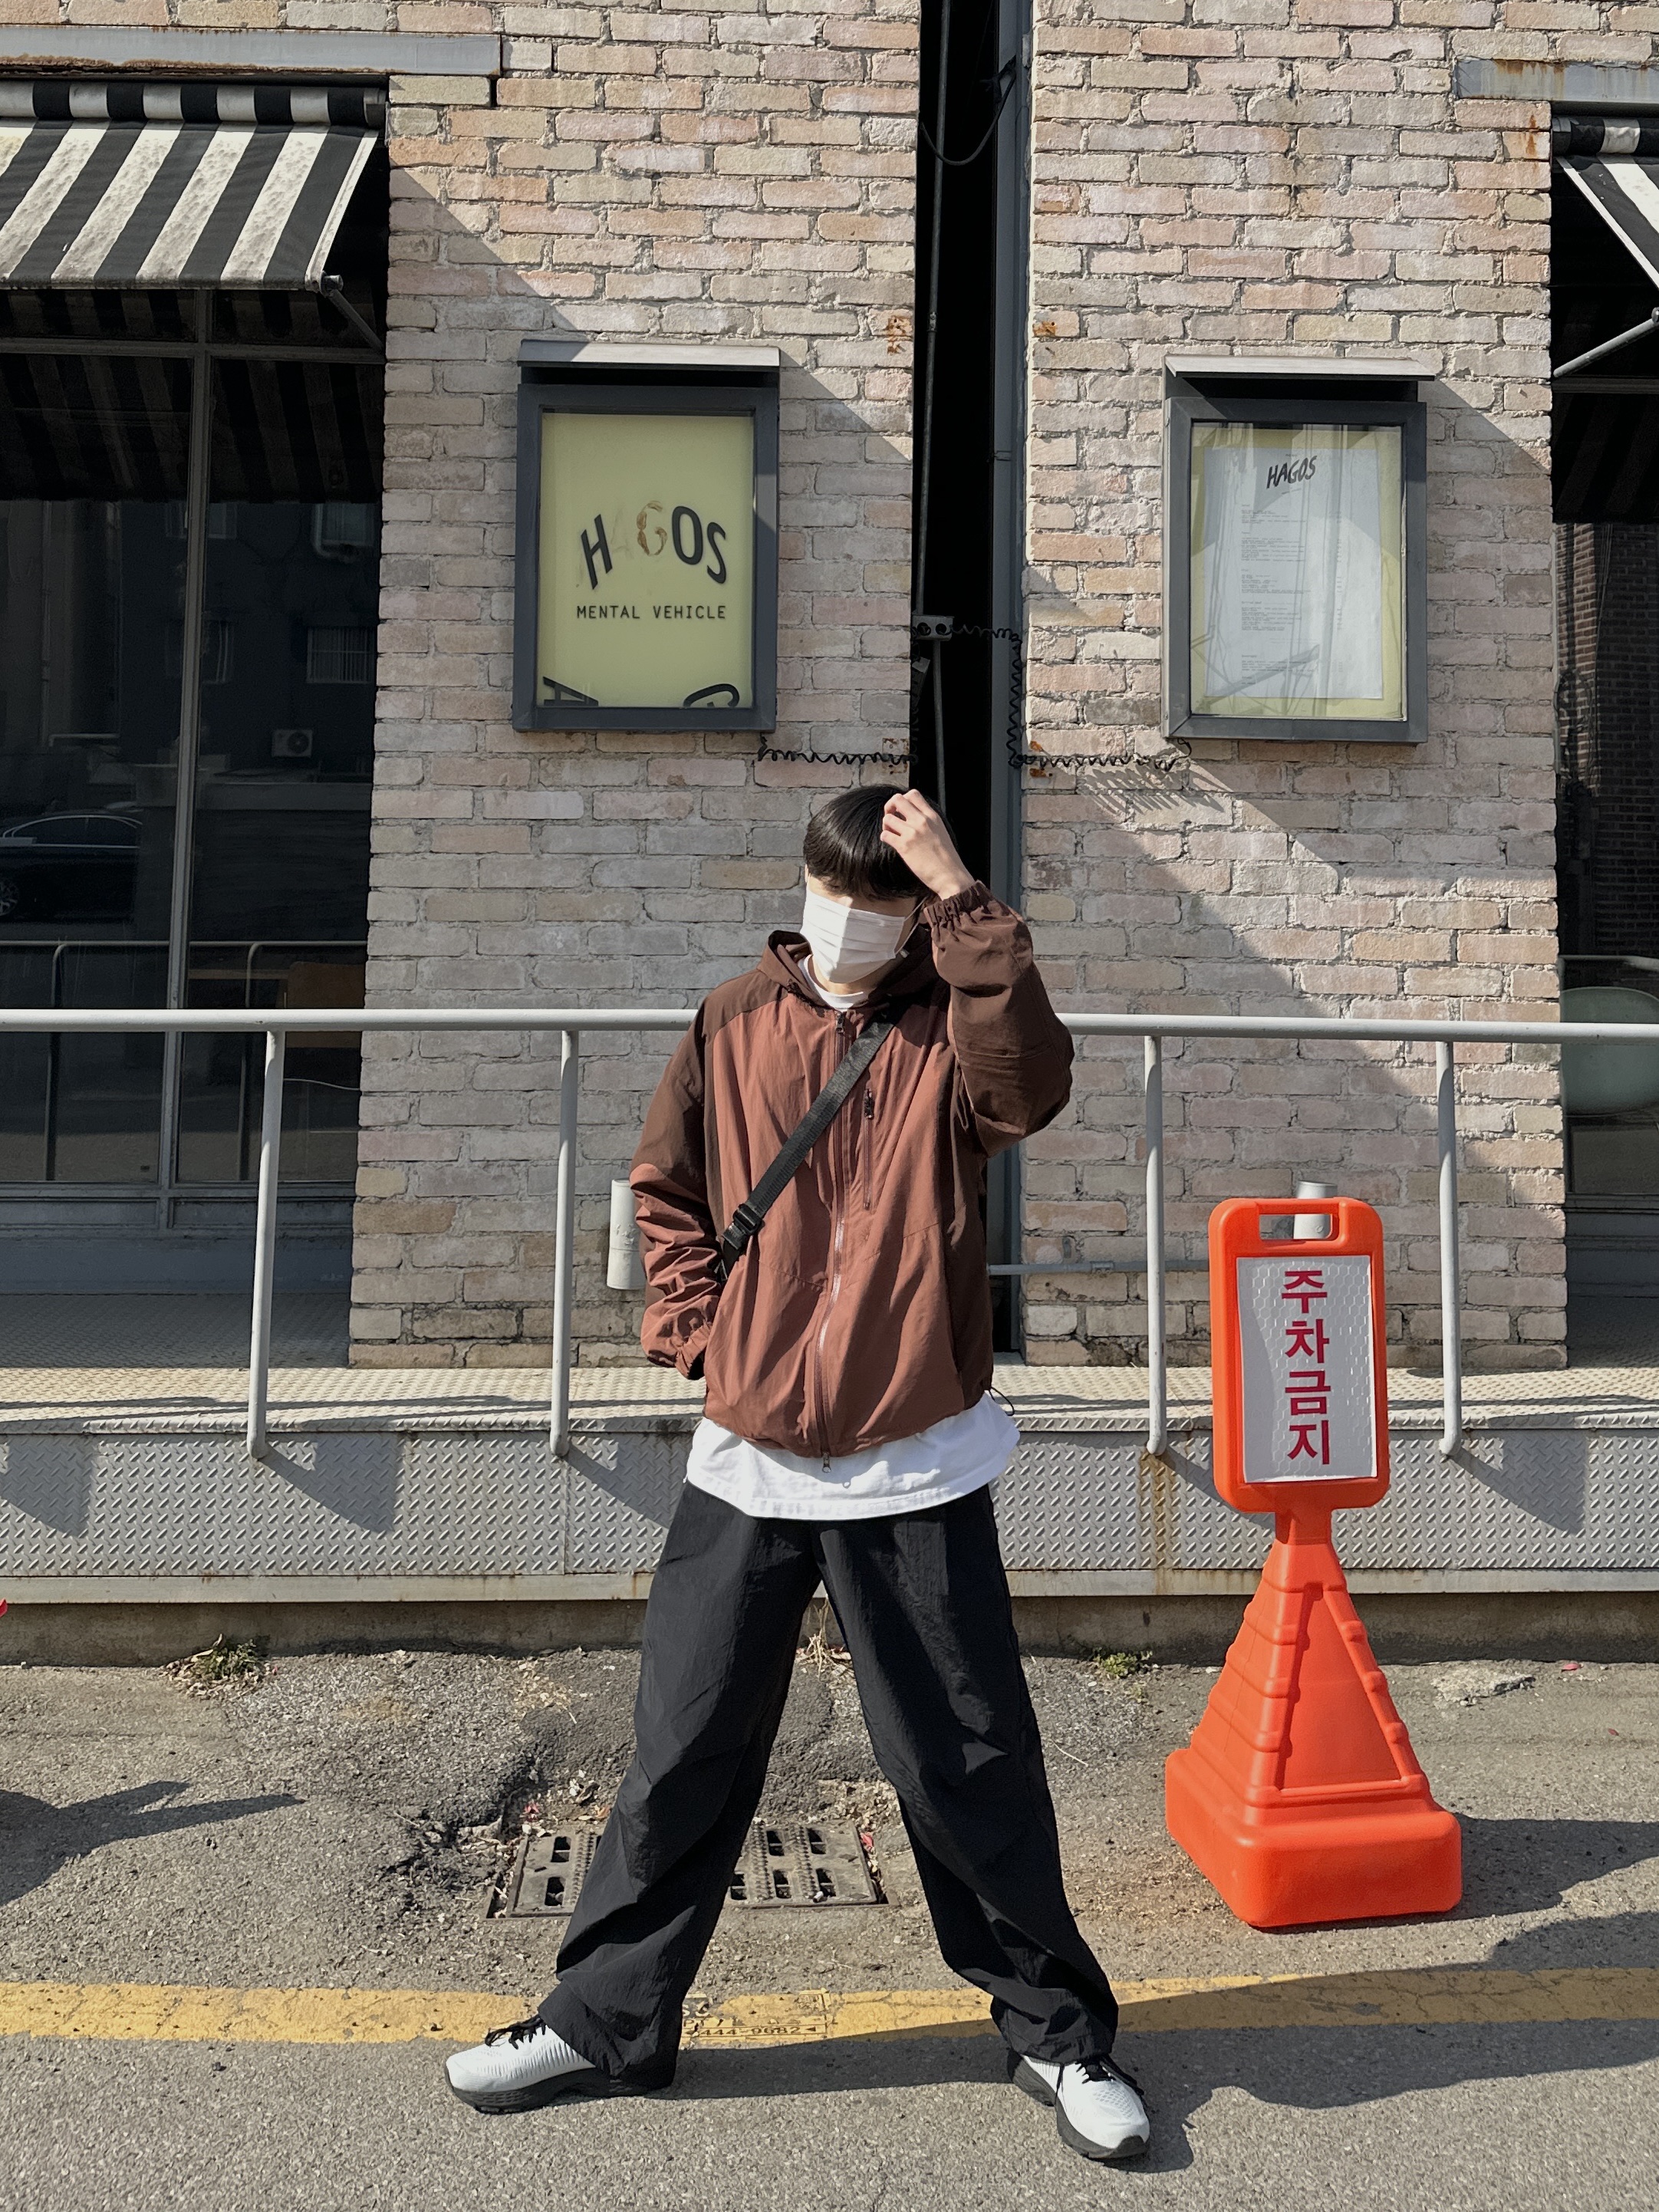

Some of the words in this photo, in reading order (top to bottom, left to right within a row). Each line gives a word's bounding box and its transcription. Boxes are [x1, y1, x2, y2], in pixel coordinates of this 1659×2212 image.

[1266, 455, 1318, 489] HAGOS
[581, 501, 727, 590] HGOS
[577, 605, 640, 619] MENTAL
[653, 605, 726, 619] VEHICLE
[1282, 1270, 1331, 1465] 주차금지
